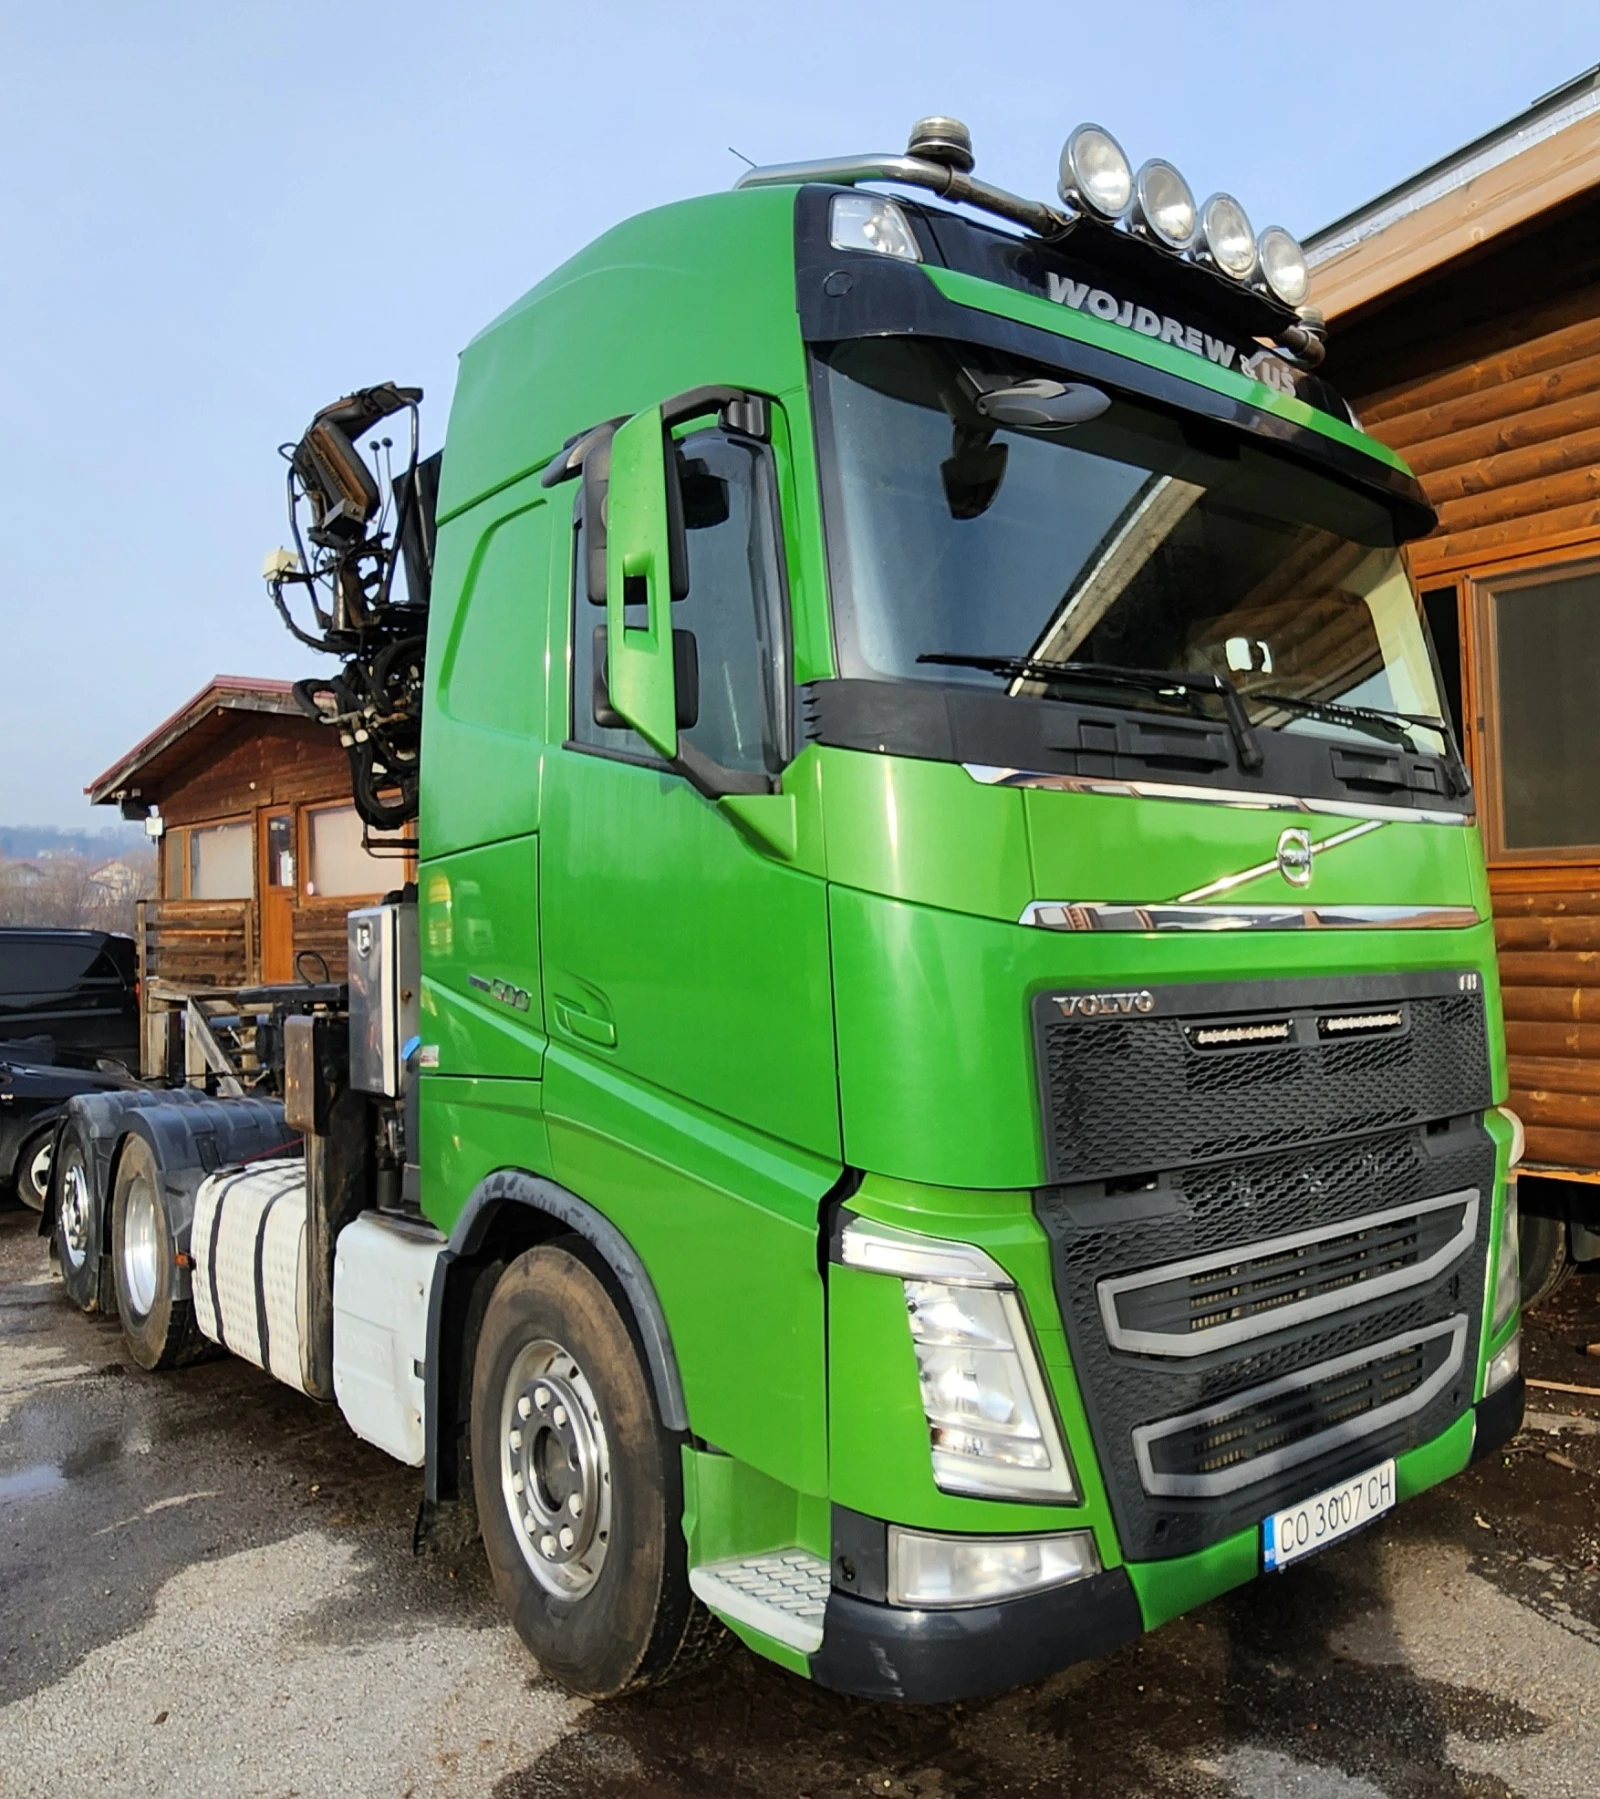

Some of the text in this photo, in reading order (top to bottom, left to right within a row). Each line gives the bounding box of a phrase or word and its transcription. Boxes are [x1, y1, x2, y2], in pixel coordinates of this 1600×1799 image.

[1046, 271, 1235, 369] WOJDREW
[1052, 990, 1156, 1017] VOLVO
[1280, 1511, 1309, 1553] CO
[1315, 1483, 1362, 1537] 3007
[1367, 1467, 1391, 1509] CH
